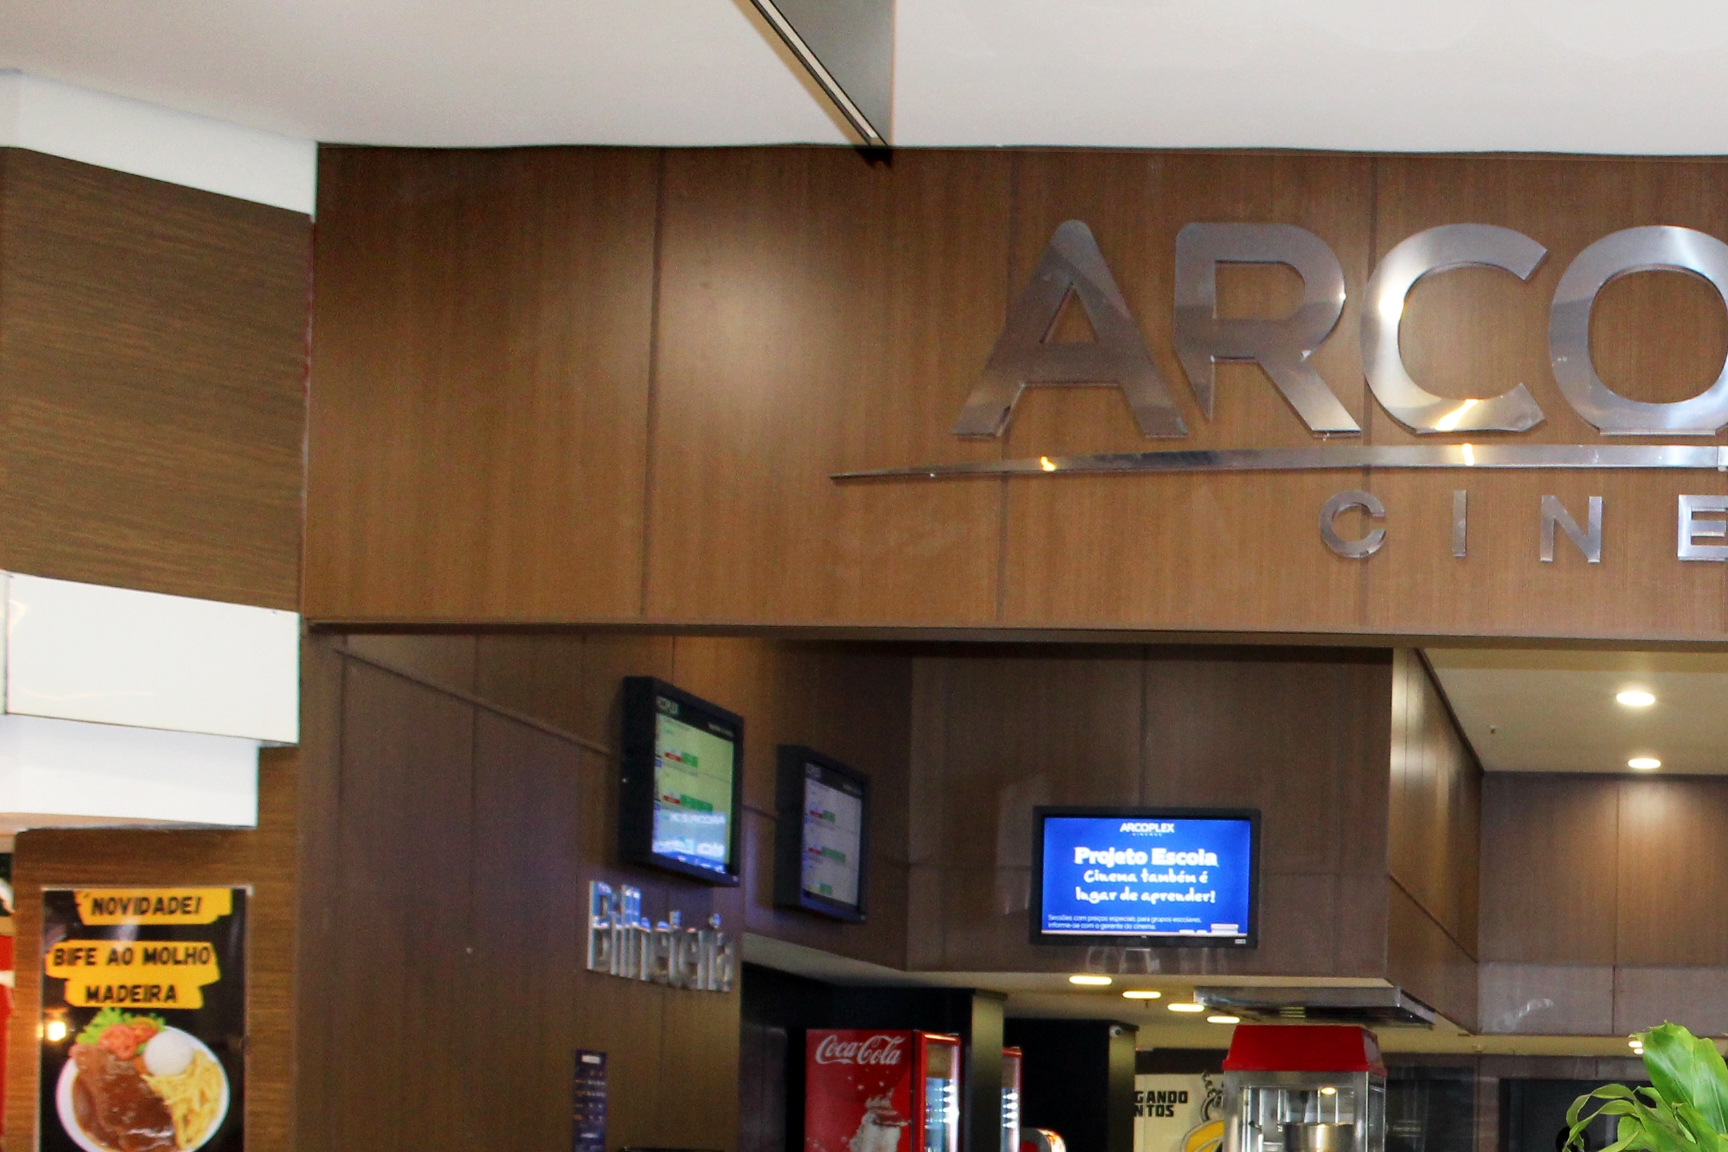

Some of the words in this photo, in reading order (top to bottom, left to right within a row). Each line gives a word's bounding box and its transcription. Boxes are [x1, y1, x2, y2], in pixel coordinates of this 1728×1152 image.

[1119, 822, 1175, 833] ARCOPLEX
[1074, 846, 1148, 868] Projeto
[1151, 848, 1218, 867] Escola
[1083, 869, 1138, 883] Cinema
[1140, 868, 1197, 883] também
[1199, 870, 1208, 883] é
[90, 895, 202, 916] NOVIDADE!
[1075, 886, 1117, 904] lugar
[1120, 886, 1138, 902] de
[1141, 887, 1216, 905] aprender!
[1048, 914, 1073, 922] Sessões
[1088, 915, 1108, 923] preços
[1109, 915, 1136, 923] especiais
[1151, 916, 1171, 924] grupos
[586, 879, 735, 993] Bilheteria
[53, 948, 97, 967] BIFE
[107, 948, 134, 967] AO
[142, 946, 211, 966] MOLHO
[85, 984, 178, 1004] MADEIRA
